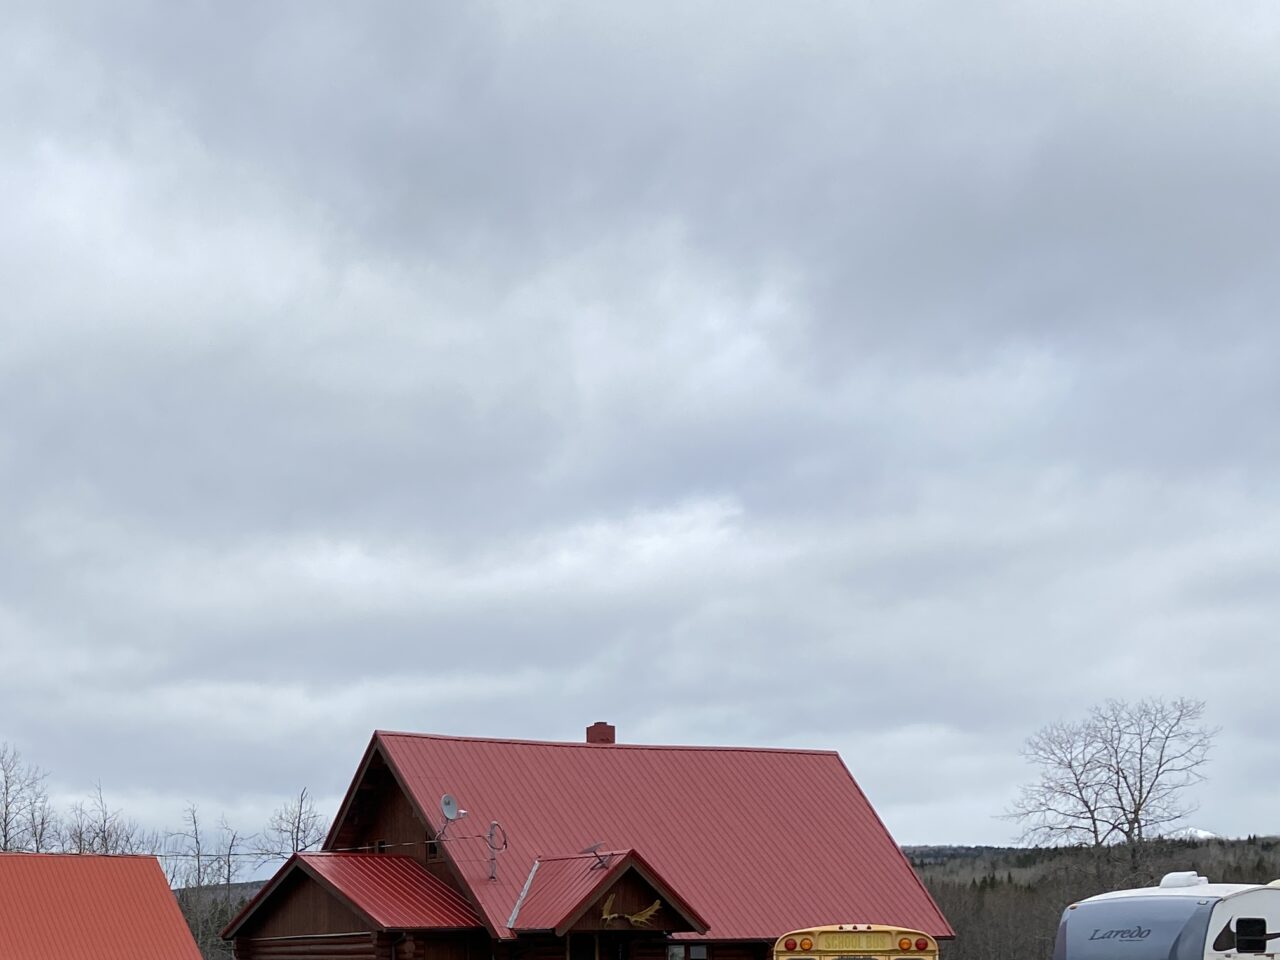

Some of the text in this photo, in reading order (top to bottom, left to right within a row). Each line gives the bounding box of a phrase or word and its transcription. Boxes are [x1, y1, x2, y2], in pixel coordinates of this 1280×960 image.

[1088, 925, 1152, 941] Laredo
[825, 935, 886, 949] SCHOOL BUS
